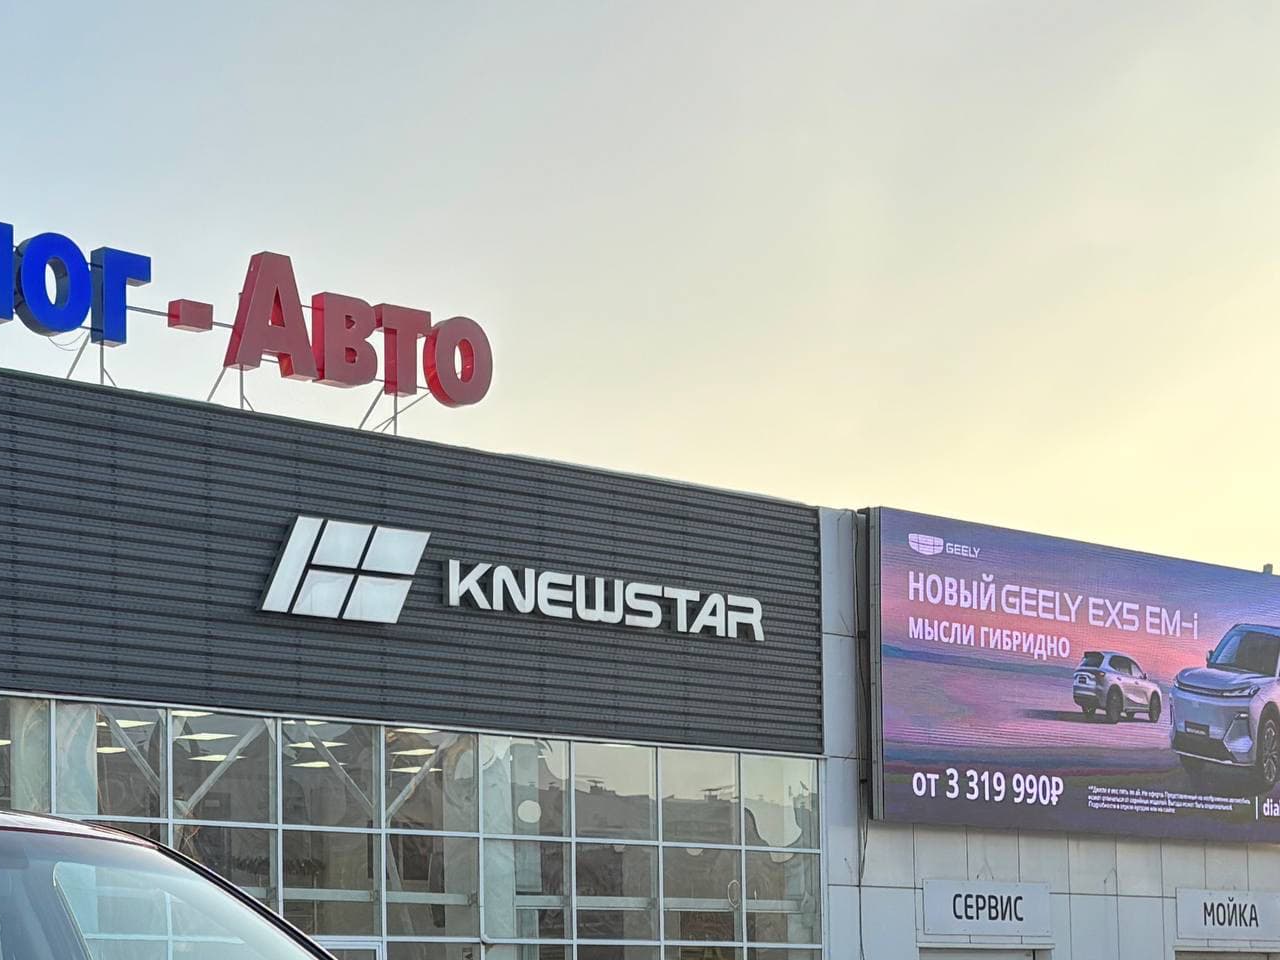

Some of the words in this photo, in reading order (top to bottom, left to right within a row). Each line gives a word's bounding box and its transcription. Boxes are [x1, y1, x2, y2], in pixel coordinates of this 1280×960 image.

[945, 542, 981, 559] GEELY
[448, 558, 766, 642] KNEWSTAR
[908, 570, 997, 612] НОВЫЙ
[1001, 583, 1083, 623] GEELY
[1088, 596, 1140, 632] EX5
[1145, 605, 1199, 640] EM-i
[908, 616, 976, 646] МЫСЛИ
[980, 626, 1071, 661] ГИБРИДНО
[945, 767, 960, 799] 3
[966, 769, 1006, 802] 319
[952, 893, 1024, 922] СЕРВИС
[1203, 897, 1259, 928] МОЙКА
